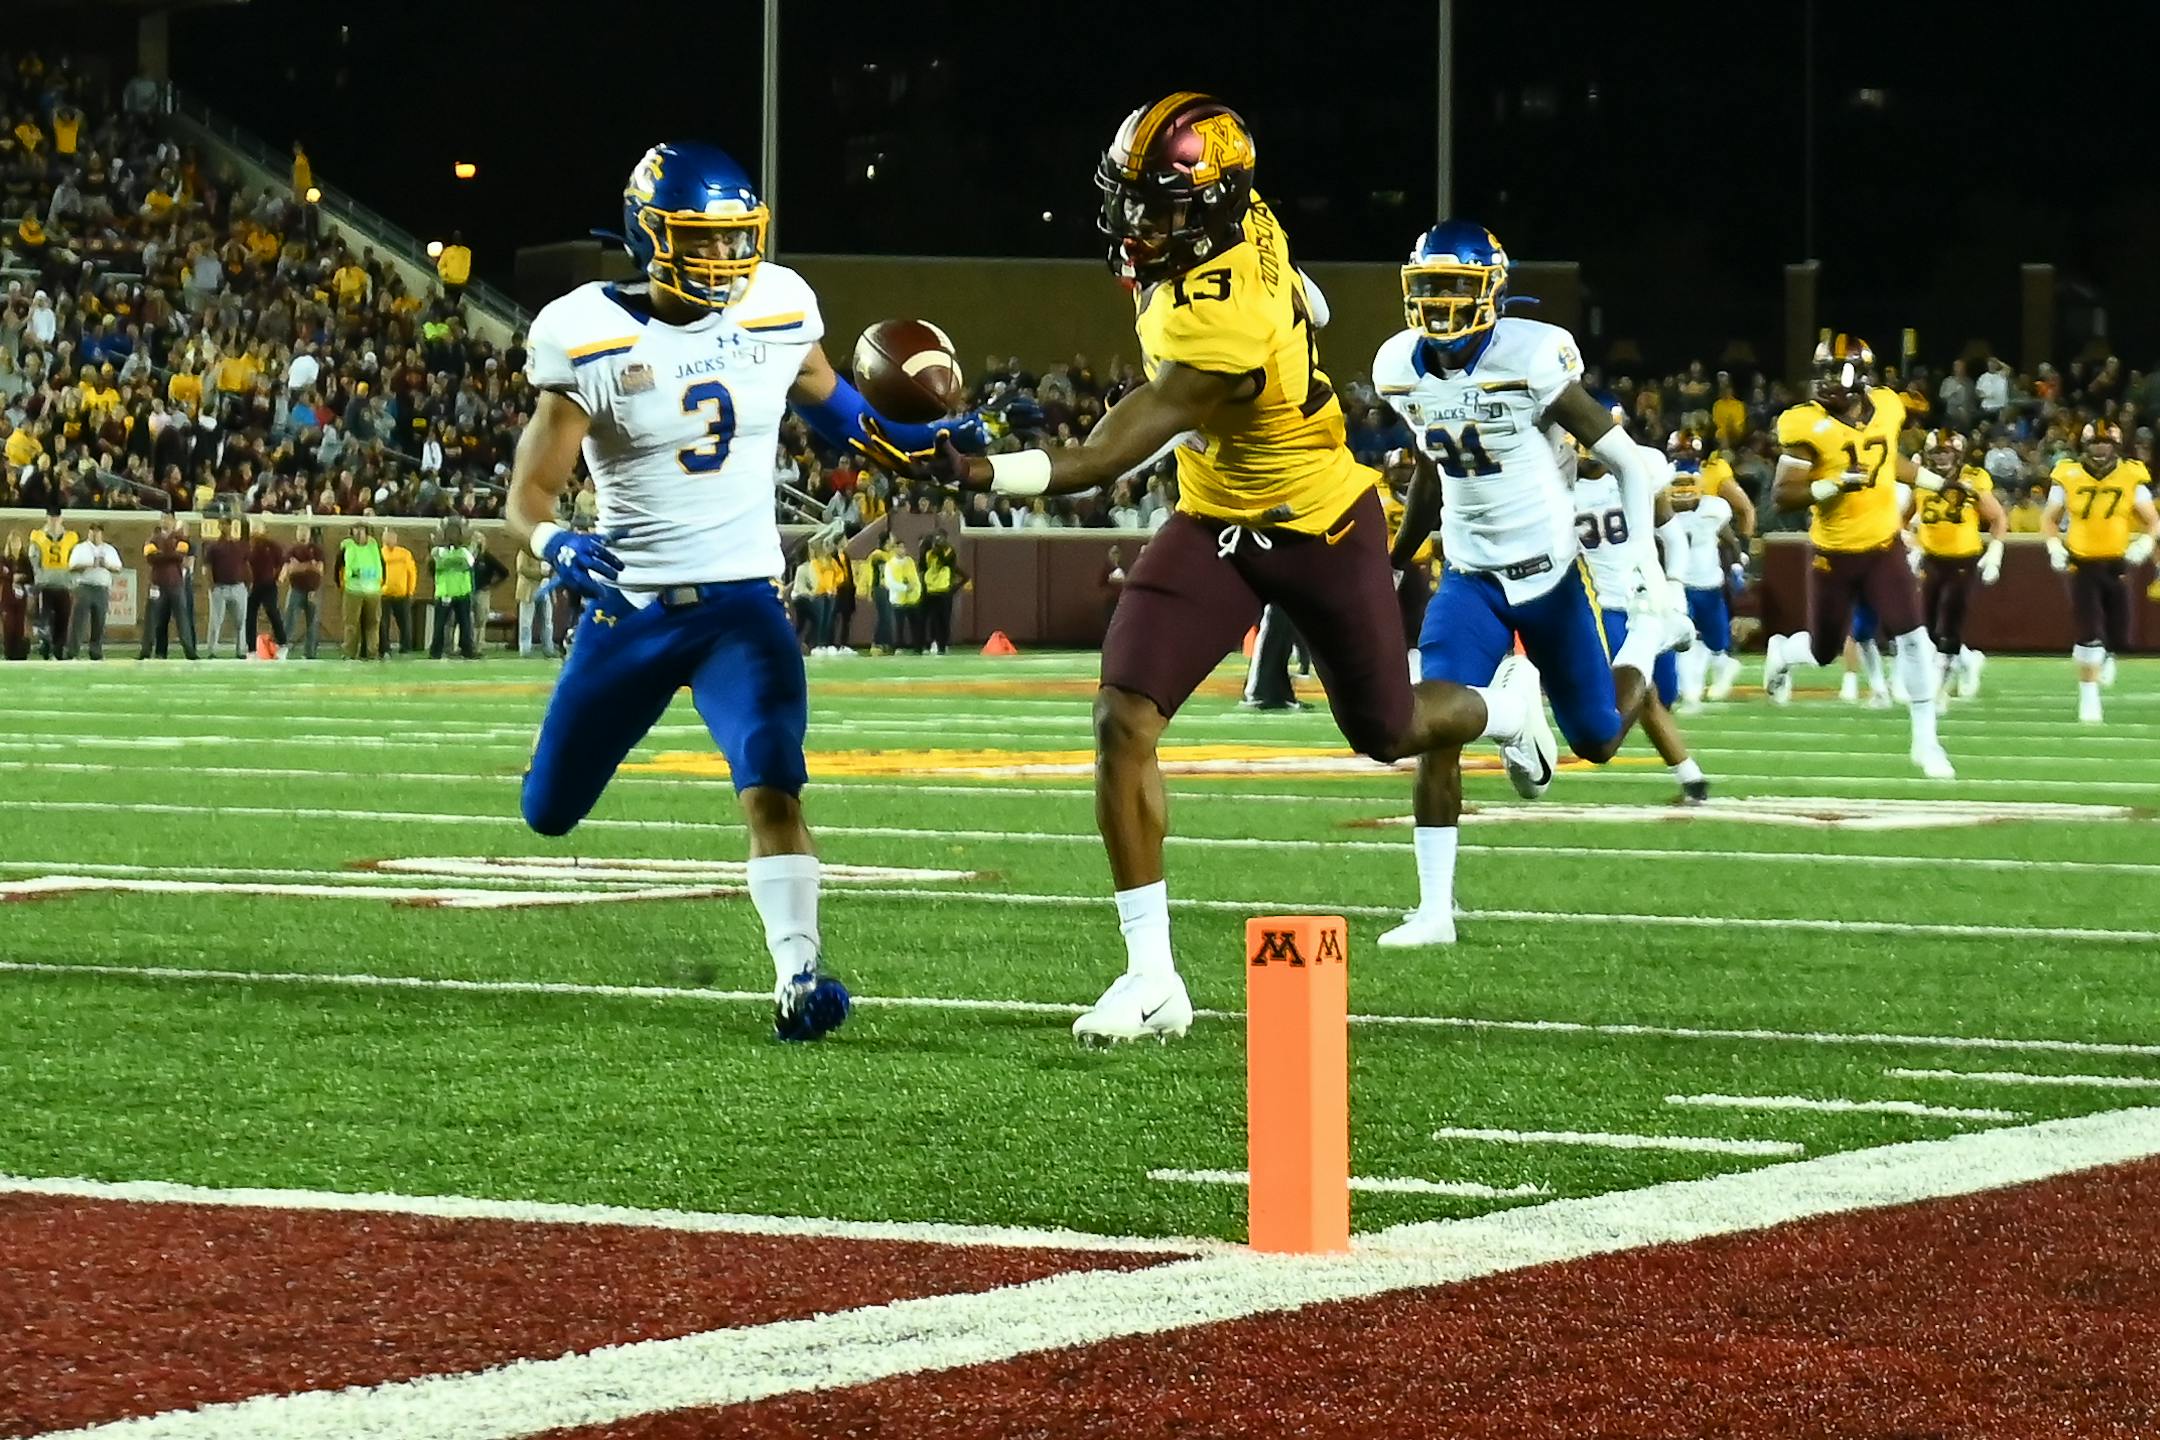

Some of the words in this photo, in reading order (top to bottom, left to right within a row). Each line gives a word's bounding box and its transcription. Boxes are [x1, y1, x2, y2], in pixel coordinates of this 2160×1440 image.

[1171, 268, 1232, 310] 13
[675, 355, 726, 379] JACKS
[677, 379, 736, 475] 3
[1433, 407, 1466, 421] JACKS
[1841, 435, 1888, 489] 17
[2075, 485, 2124, 521] 77
[1250, 929, 1306, 968] M
[1315, 928, 1343, 965] M
